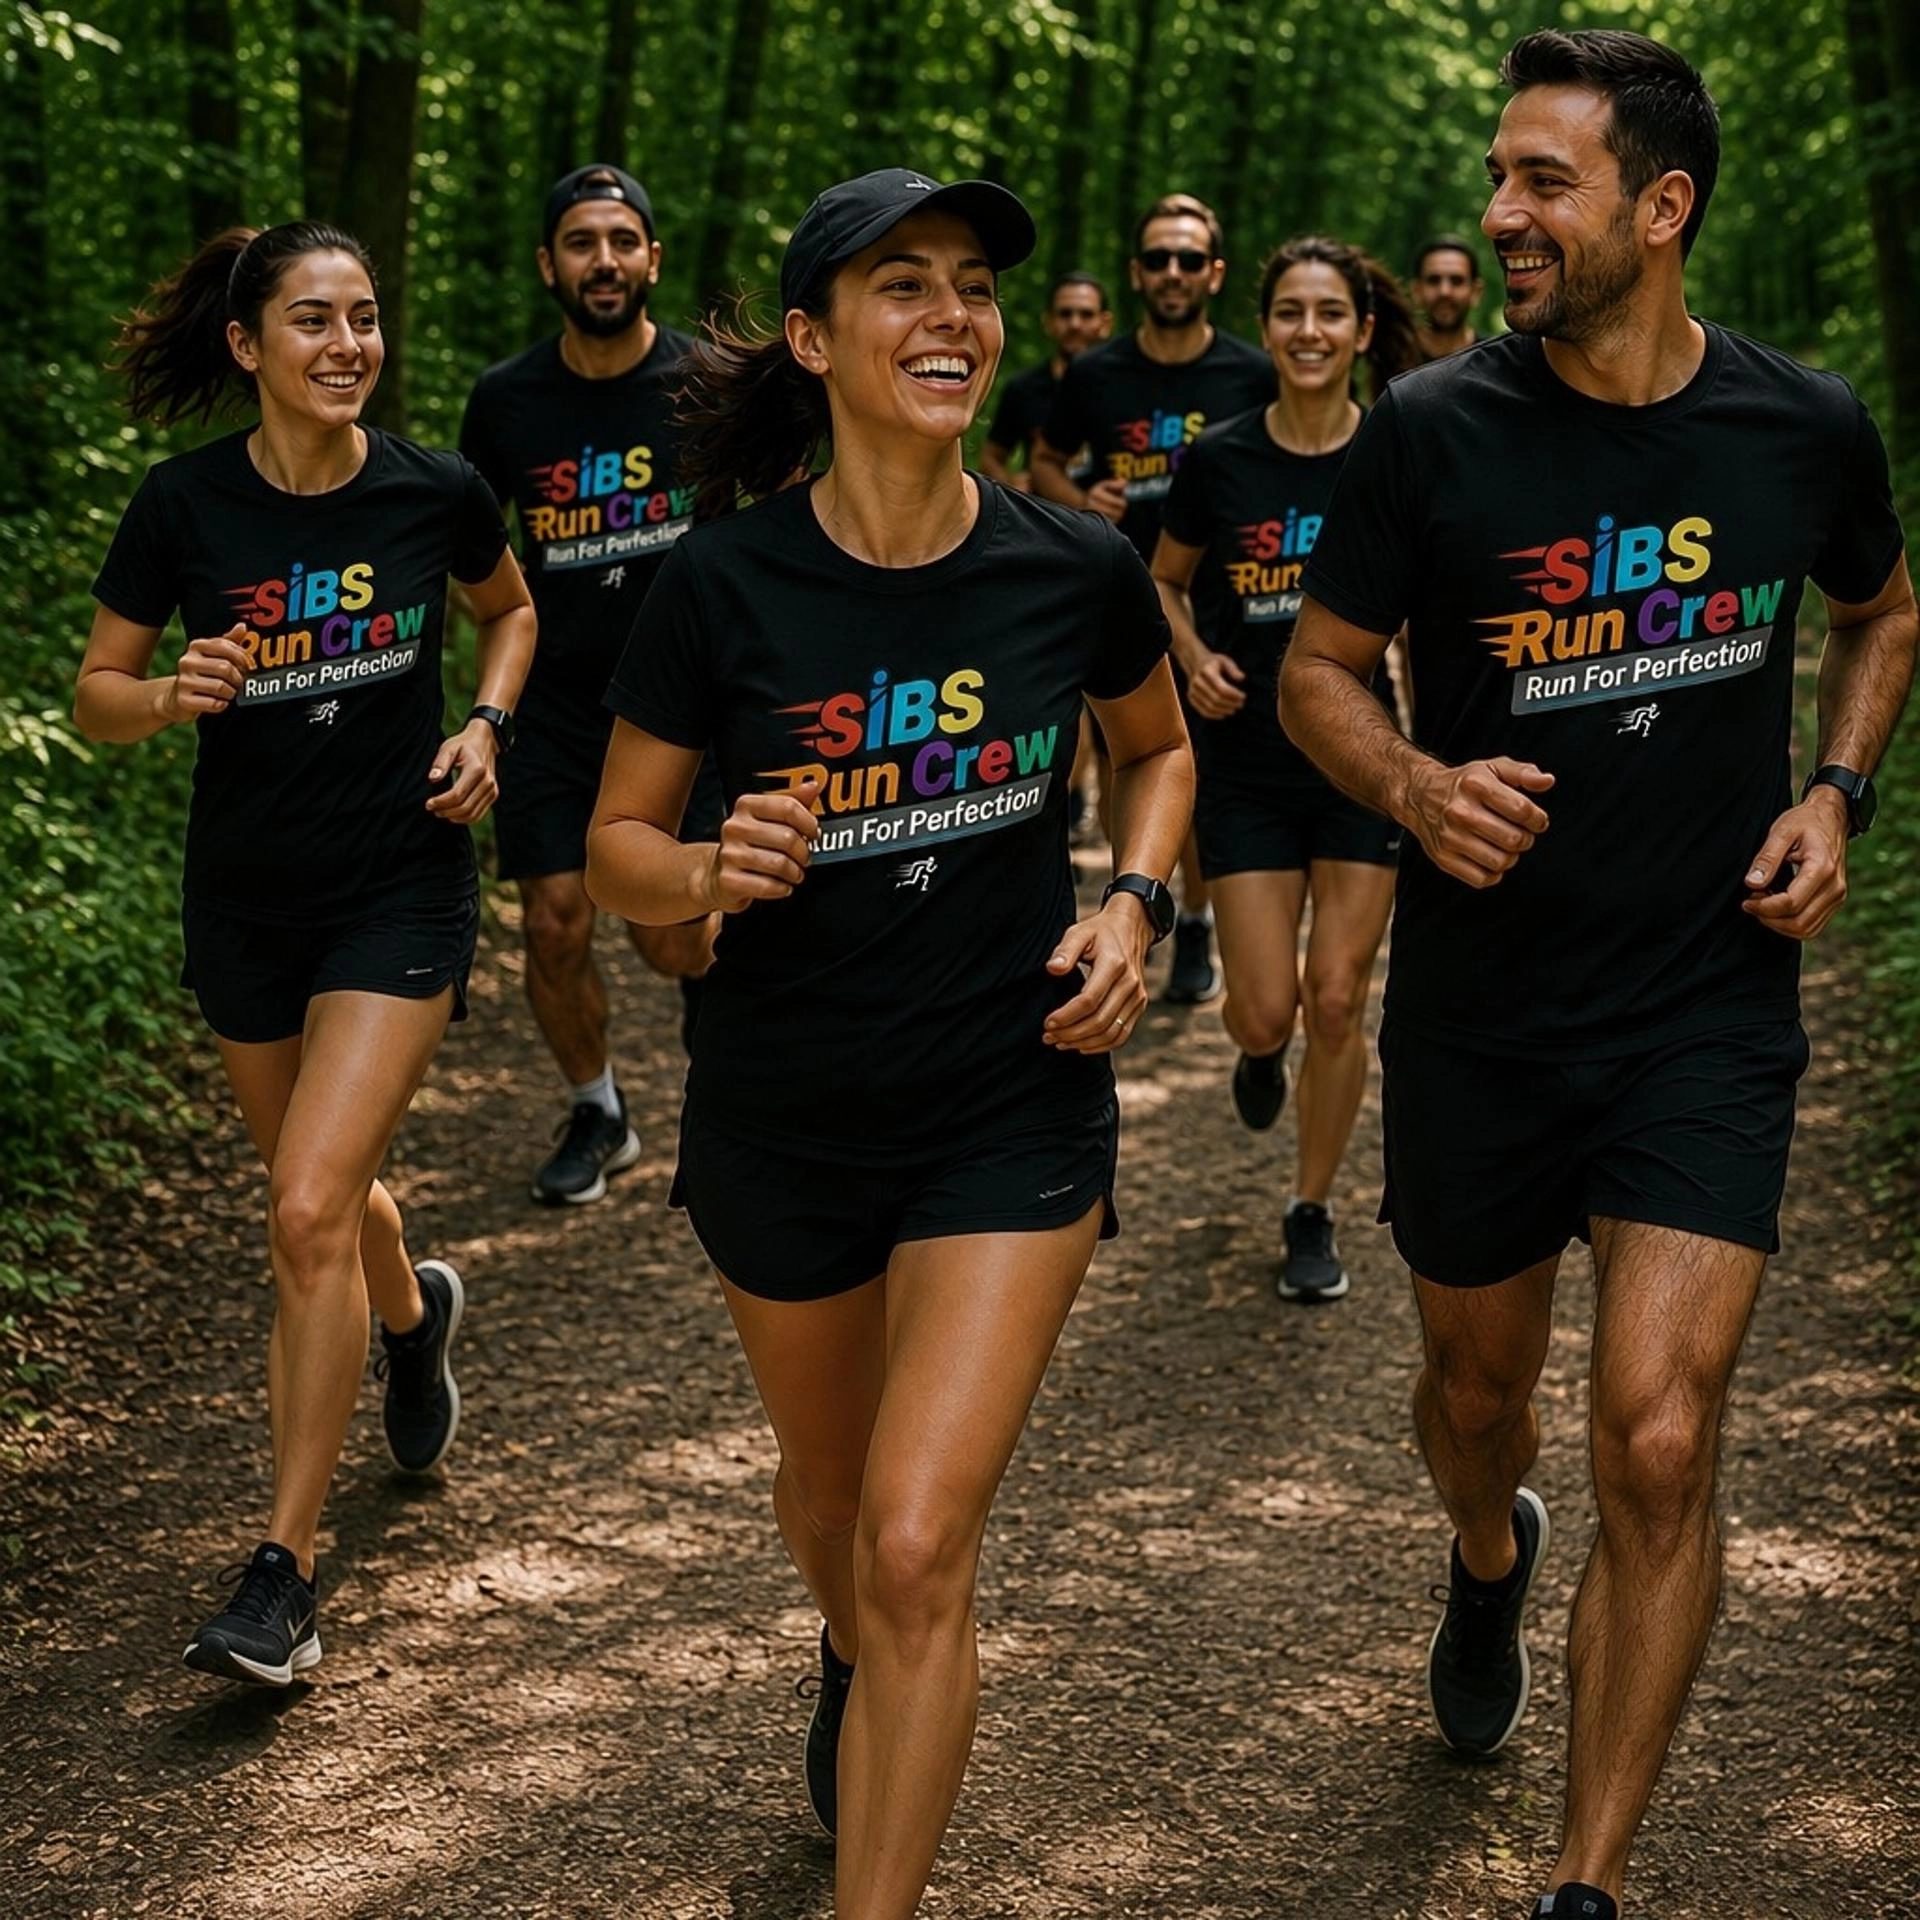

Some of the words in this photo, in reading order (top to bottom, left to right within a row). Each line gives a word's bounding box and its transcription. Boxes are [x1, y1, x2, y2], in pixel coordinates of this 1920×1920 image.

[1112, 452, 1168, 480] Run
[530, 505, 601, 541] Run
[1255, 507, 1323, 559] SiB
[547, 547, 575, 564] Run
[578, 541, 603, 560] For
[1236, 561, 1303, 596] Run
[320, 603, 427, 657] Crew
[1504, 609, 1626, 669] Run
[1637, 578, 1786, 645] Crew
[244, 678, 280, 698] Run
[285, 671, 316, 691] For
[319, 649, 414, 685] Perfection
[1525, 675, 1576, 701] Run
[1584, 665, 1627, 692] For
[1632, 638, 1763, 684] Perfection
[911, 724, 1059, 797] Crew
[860, 818, 903, 845] For
[909, 785, 1041, 837] Perfection
